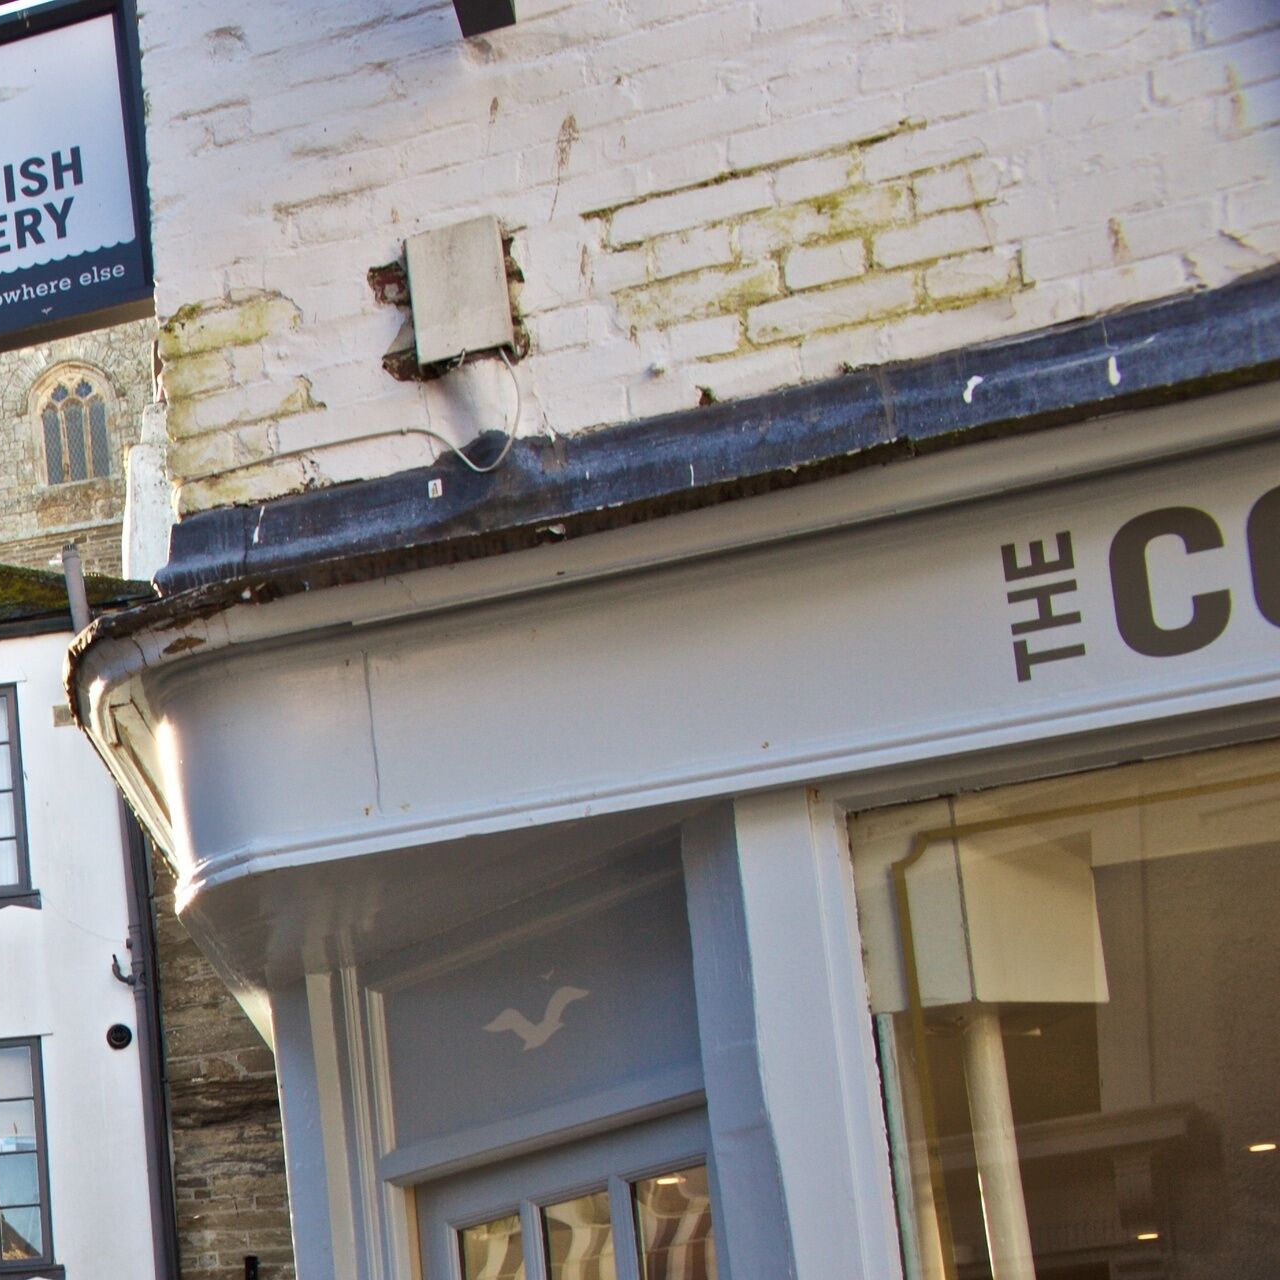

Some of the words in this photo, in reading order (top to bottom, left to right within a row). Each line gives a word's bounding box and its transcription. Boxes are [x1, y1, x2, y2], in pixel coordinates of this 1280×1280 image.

[78, 262, 127, 288] else
[1000, 530, 1086, 683] THE
[1109, 485, 1280, 658] C
